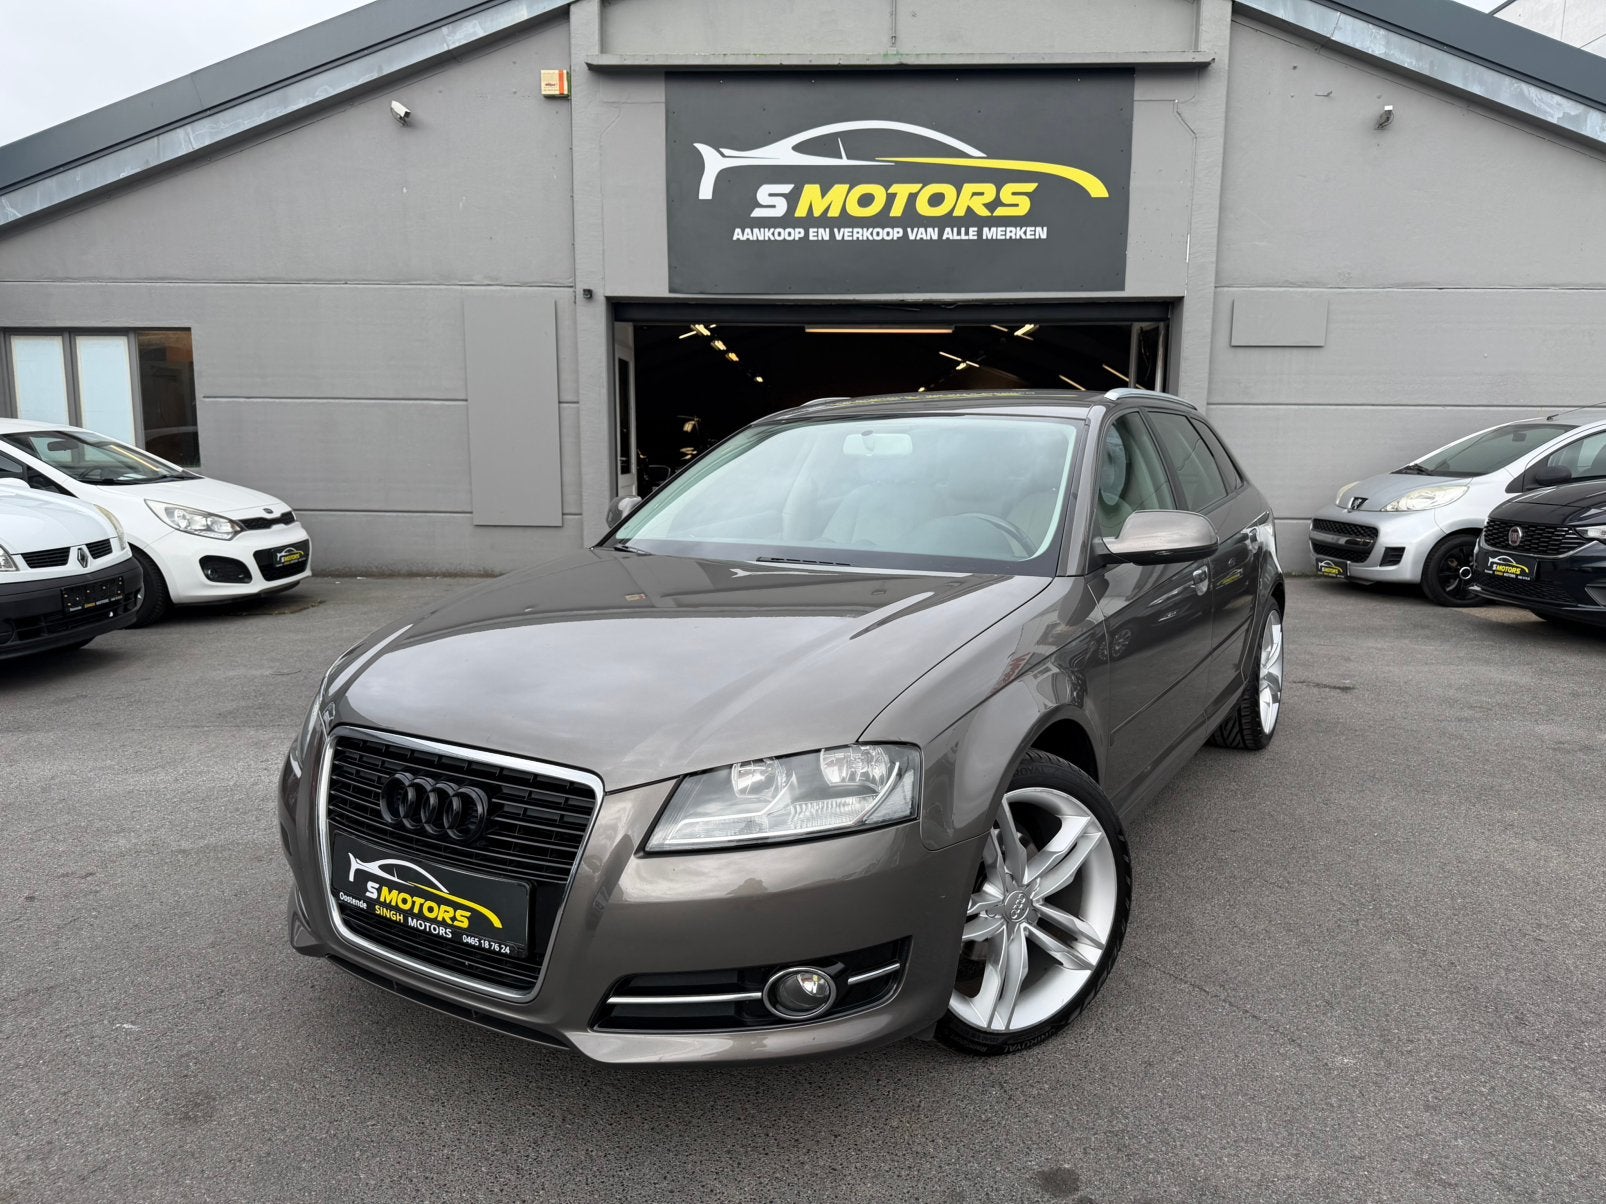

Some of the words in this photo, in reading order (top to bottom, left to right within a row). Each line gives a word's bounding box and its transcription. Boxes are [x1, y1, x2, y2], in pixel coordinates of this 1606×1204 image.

[750, 183, 795, 218] S
[794, 182, 1039, 218] MOTORS
[732, 227, 805, 241] AANKOOP
[808, 227, 830, 241] EN
[833, 227, 903, 241] VERKOOP
[907, 227, 939, 240] VAN
[942, 227, 978, 240] ALLE
[982, 226, 1047, 240] MERKEN
[1497, 565, 1521, 574] MOTORS
[1013, 765, 1047, 777] ROYAL
[339, 891, 368, 910] Oostende
[365, 880, 380, 899] S
[379, 886, 472, 929] MOTORS
[375, 905, 404, 923] SINGH
[407, 916, 452, 938] MOTORS
[462, 934, 479, 946] 0465
[480, 939, 489, 949] 18
[490, 942, 500, 952] 76
[500, 944, 510, 954] 24
